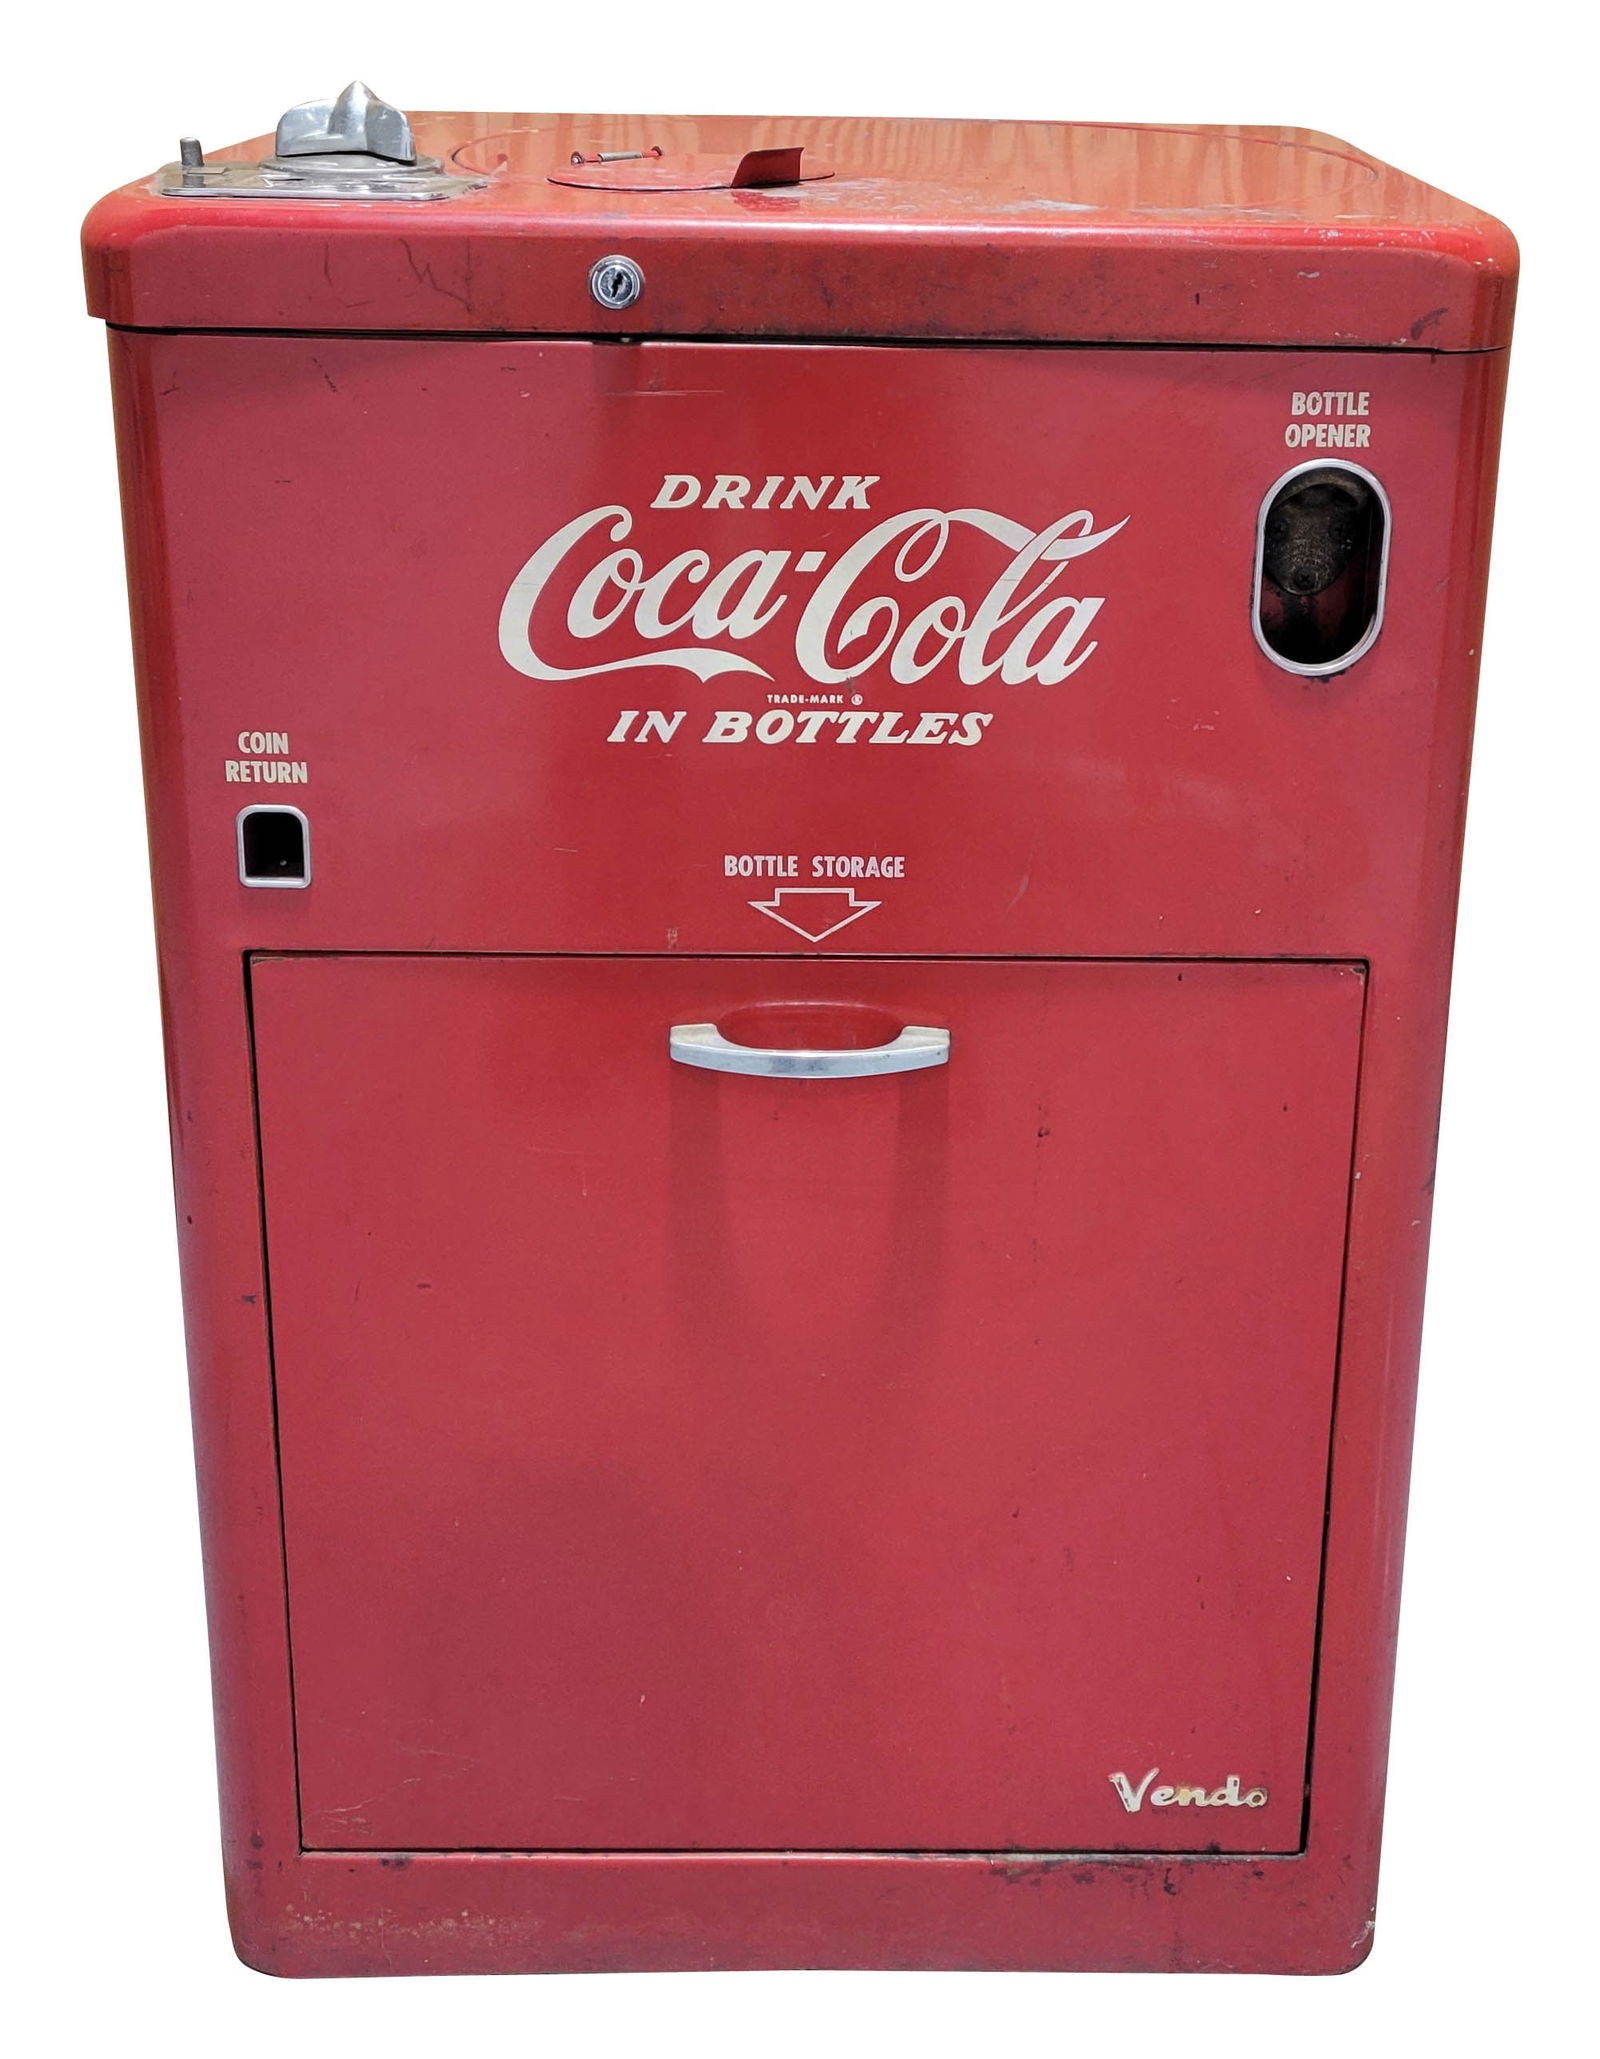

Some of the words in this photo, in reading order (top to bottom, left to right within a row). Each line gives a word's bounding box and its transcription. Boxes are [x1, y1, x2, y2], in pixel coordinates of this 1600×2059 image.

[1291, 391, 1370, 416] BOTTLE
[1285, 423, 1371, 448] OPENER
[650, 474, 881, 510] DRINK
[498, 504, 1131, 686] Coca-Cola
[766, 694, 844, 704] TRADE-MARK
[606, 711, 687, 744] IN
[702, 710, 993, 746] BOTTLES
[238, 731, 289, 755] COIN
[225, 760, 309, 784] RETURN
[724, 855, 799, 877] BOTTLE
[812, 855, 906, 878] STORAGE
[1108, 1767, 1269, 1813] Vendo
